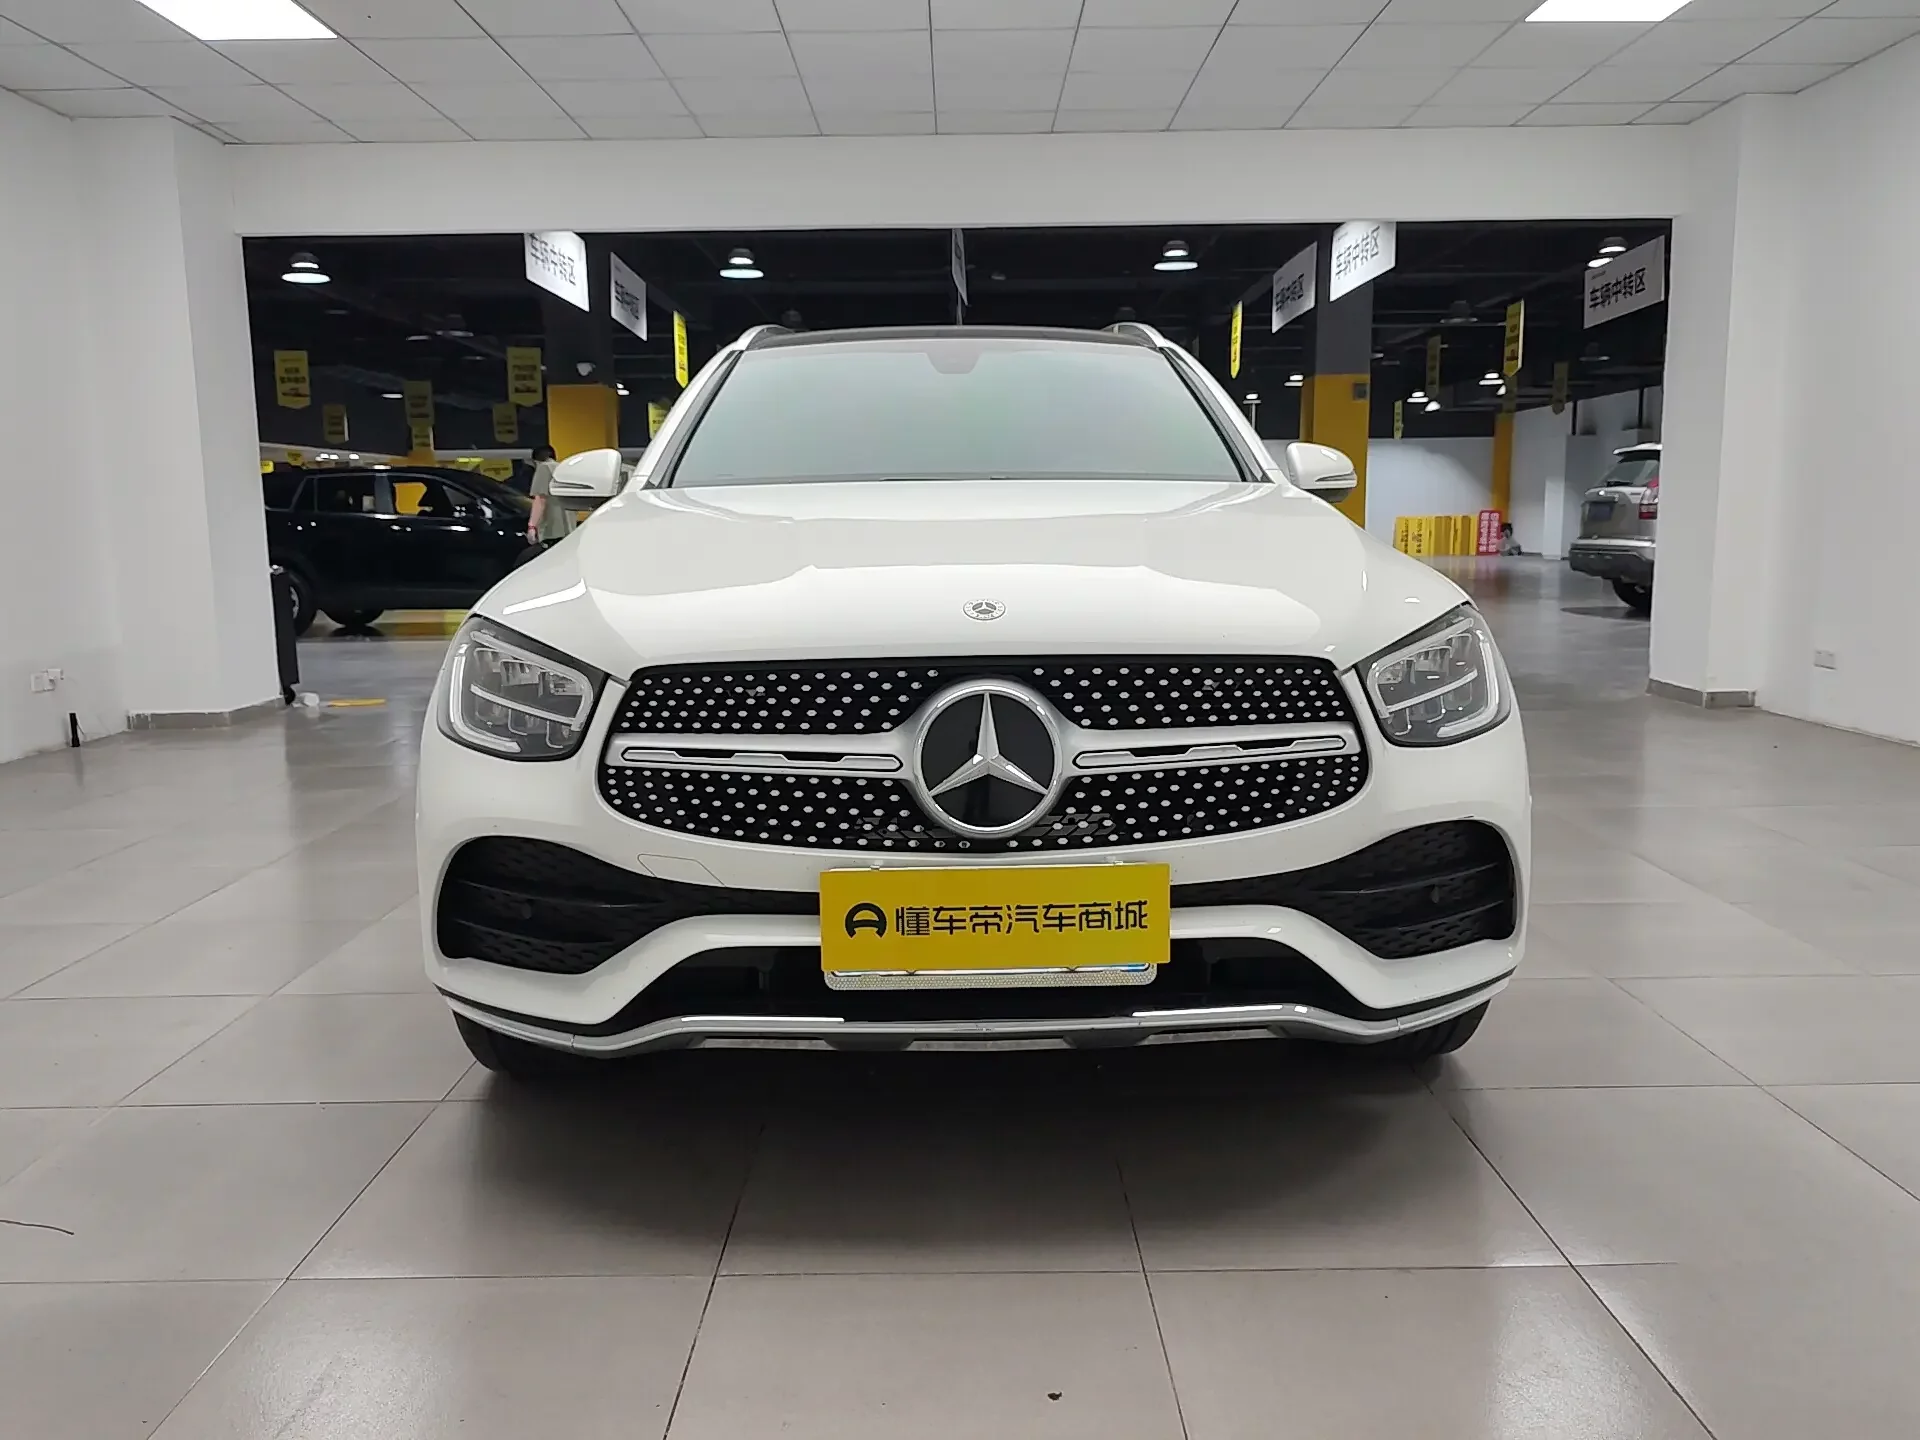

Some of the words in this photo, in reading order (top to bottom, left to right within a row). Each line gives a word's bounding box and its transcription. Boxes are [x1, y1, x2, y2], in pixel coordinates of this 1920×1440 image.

[1335, 225, 1380, 279] 车辆中转区
[1589, 267, 1646, 311] 车辆中转区
[895, 899, 1149, 937] 懂车帝汽车商城
